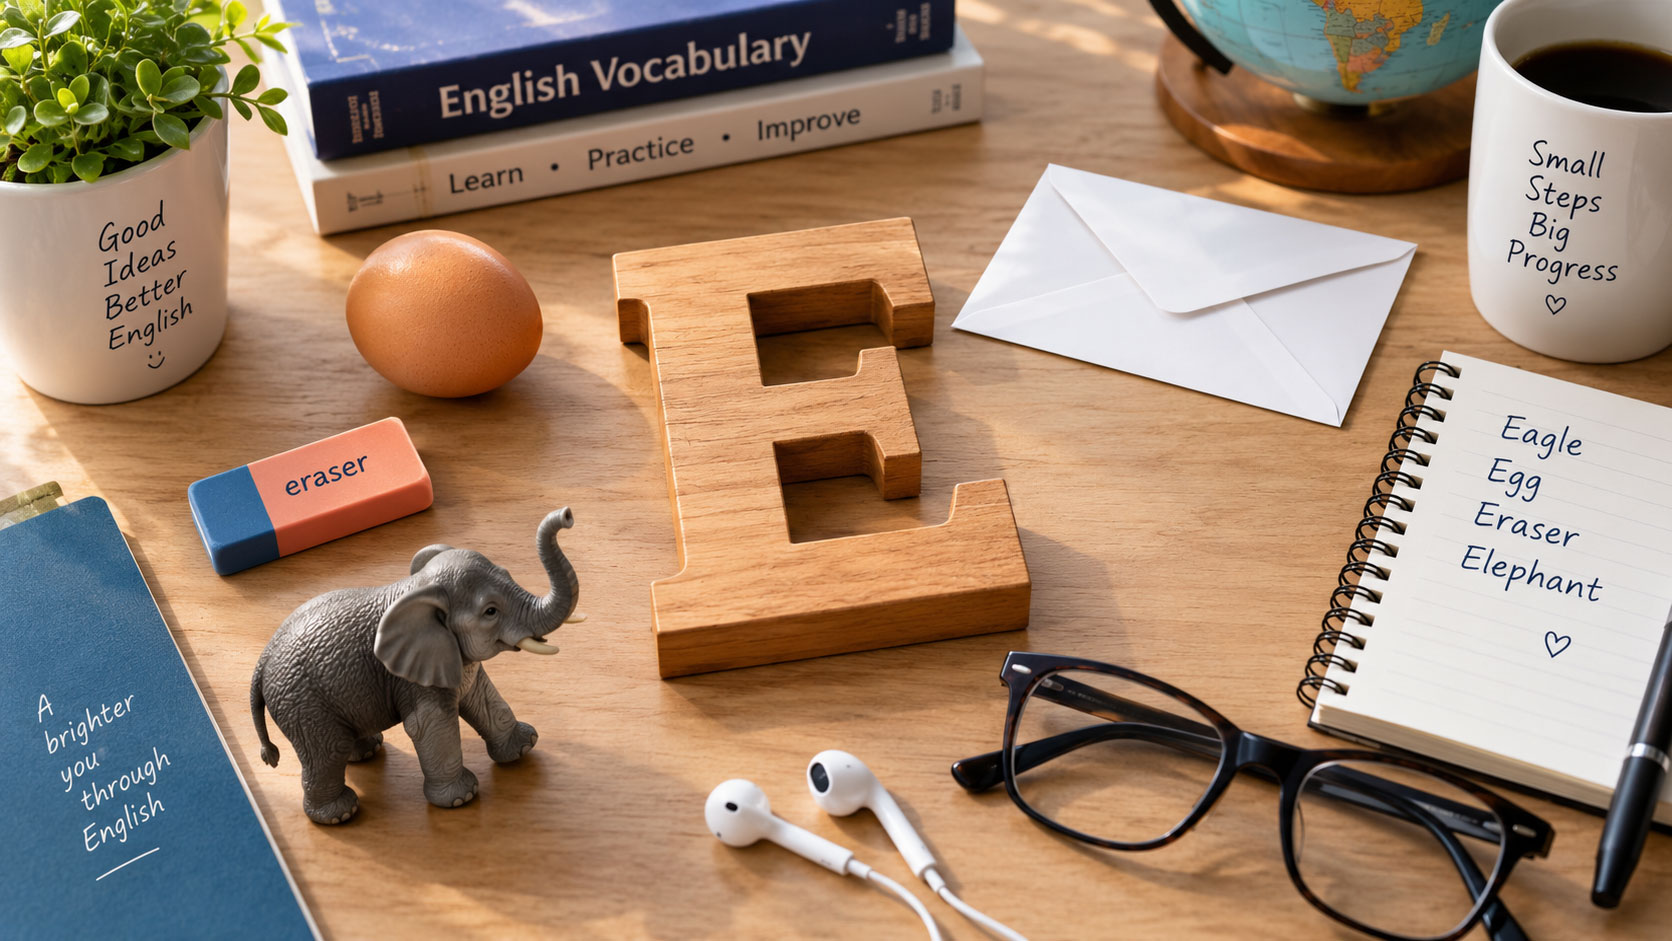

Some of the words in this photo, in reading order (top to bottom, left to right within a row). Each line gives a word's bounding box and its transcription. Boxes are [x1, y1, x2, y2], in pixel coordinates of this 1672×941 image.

[438, 63, 581, 118] English
[590, 32, 812, 91] Vocabulary
[449, 166, 524, 194] Learn
[588, 137, 695, 170] Practice
[757, 103, 862, 143] Improve
[1528, 139, 1605, 178] Small
[1525, 175, 1602, 220] Steps
[98, 199, 165, 252] Good
[1529, 212, 1570, 252] Big
[103, 240, 177, 288] Ideas
[1507, 239, 1619, 285] Progress
[104, 269, 187, 320] Better
[108, 296, 193, 350] English
[612, 216, 1032, 678] E
[1501, 415, 1583, 460] Eagle
[284, 455, 368, 496] eraser
[1487, 458, 1542, 502] Egg
[1474, 501, 1580, 547] Eraser
[1461, 545, 1603, 602] Elephant
[37, 693, 54, 723] A
[44, 694, 134, 754] brighter
[60, 752, 100, 792] you
[81, 746, 171, 811] through
[83, 792, 165, 852] English
